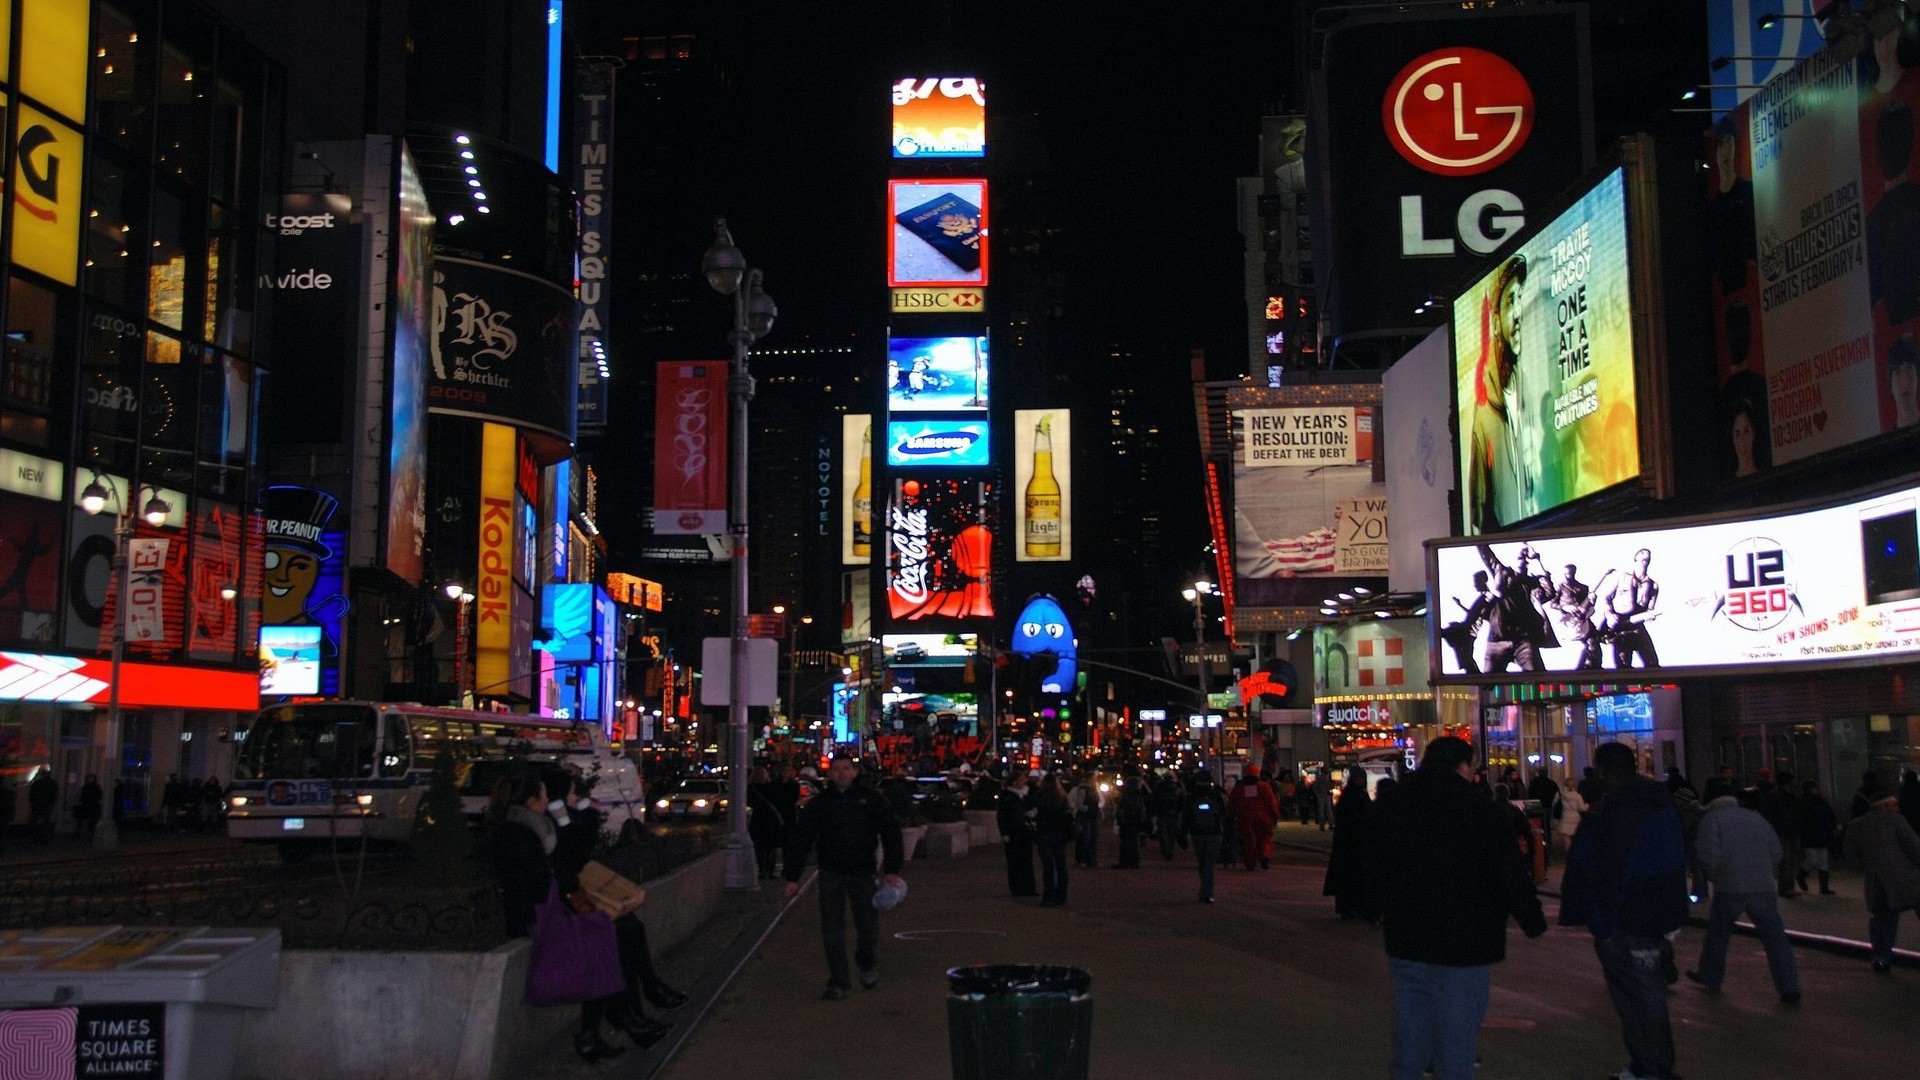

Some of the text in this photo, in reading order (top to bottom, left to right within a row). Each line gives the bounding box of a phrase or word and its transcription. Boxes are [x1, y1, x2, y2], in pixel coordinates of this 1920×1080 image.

[1752, 61, 1808, 119] IMPORTANT
[1400, 189, 1525, 256] LG
[578, 95, 607, 386] TIMES SQUARE
[1550, 225, 1590, 270] TRAVIE
[1786, 205, 1860, 271] THURSDAYS
[1763, 273, 1799, 312] STARTS
[1801, 245, 1855, 295] FEBRUARY
[1855, 241, 1862, 266] 4
[894, 293, 949, 308] HSBC
[1558, 284, 1588, 328] ONE
[1560, 318, 1588, 355] AT A
[1559, 343, 1591, 381] TIME
[1780, 359, 1811, 393] SARAH
[1814, 335, 1870, 380] SILVERMAN
[452, 367, 512, 389] Sheckler
[430, 385, 486, 404] 2009
[1771, 383, 1822, 424] PROGRAM
[1252, 414, 1348, 430] NEW YEAR'S
[1773, 415, 1813, 448] 10:30PM
[907, 437, 970, 449] SAMSUNG
[1253, 430, 1349, 446] RESOLUTION:
[1253, 448, 1347, 460] DEFEAT THE DEBT
[18, 466, 44, 484] NEW
[819, 448, 831, 535] NOVOTEL
[1352, 501, 1360, 512] I
[280, 519, 321, 541] PEANUT
[1030, 521, 1058, 534] Light
[481, 497, 511, 625] Kodak
[893, 506, 928, 604] Coca-Cola
[1341, 546, 1387, 558] TO GIVE
[1726, 549, 1785, 589] U2
[1777, 630, 1796, 644] NEW
[1798, 618, 1829, 639] SHOWS
[1328, 706, 1379, 723] swatch
[90, 1019, 150, 1037] TIMES
[80, 1039, 157, 1058] SQUARE
[86, 1059, 152, 1073] ALLIANCE
